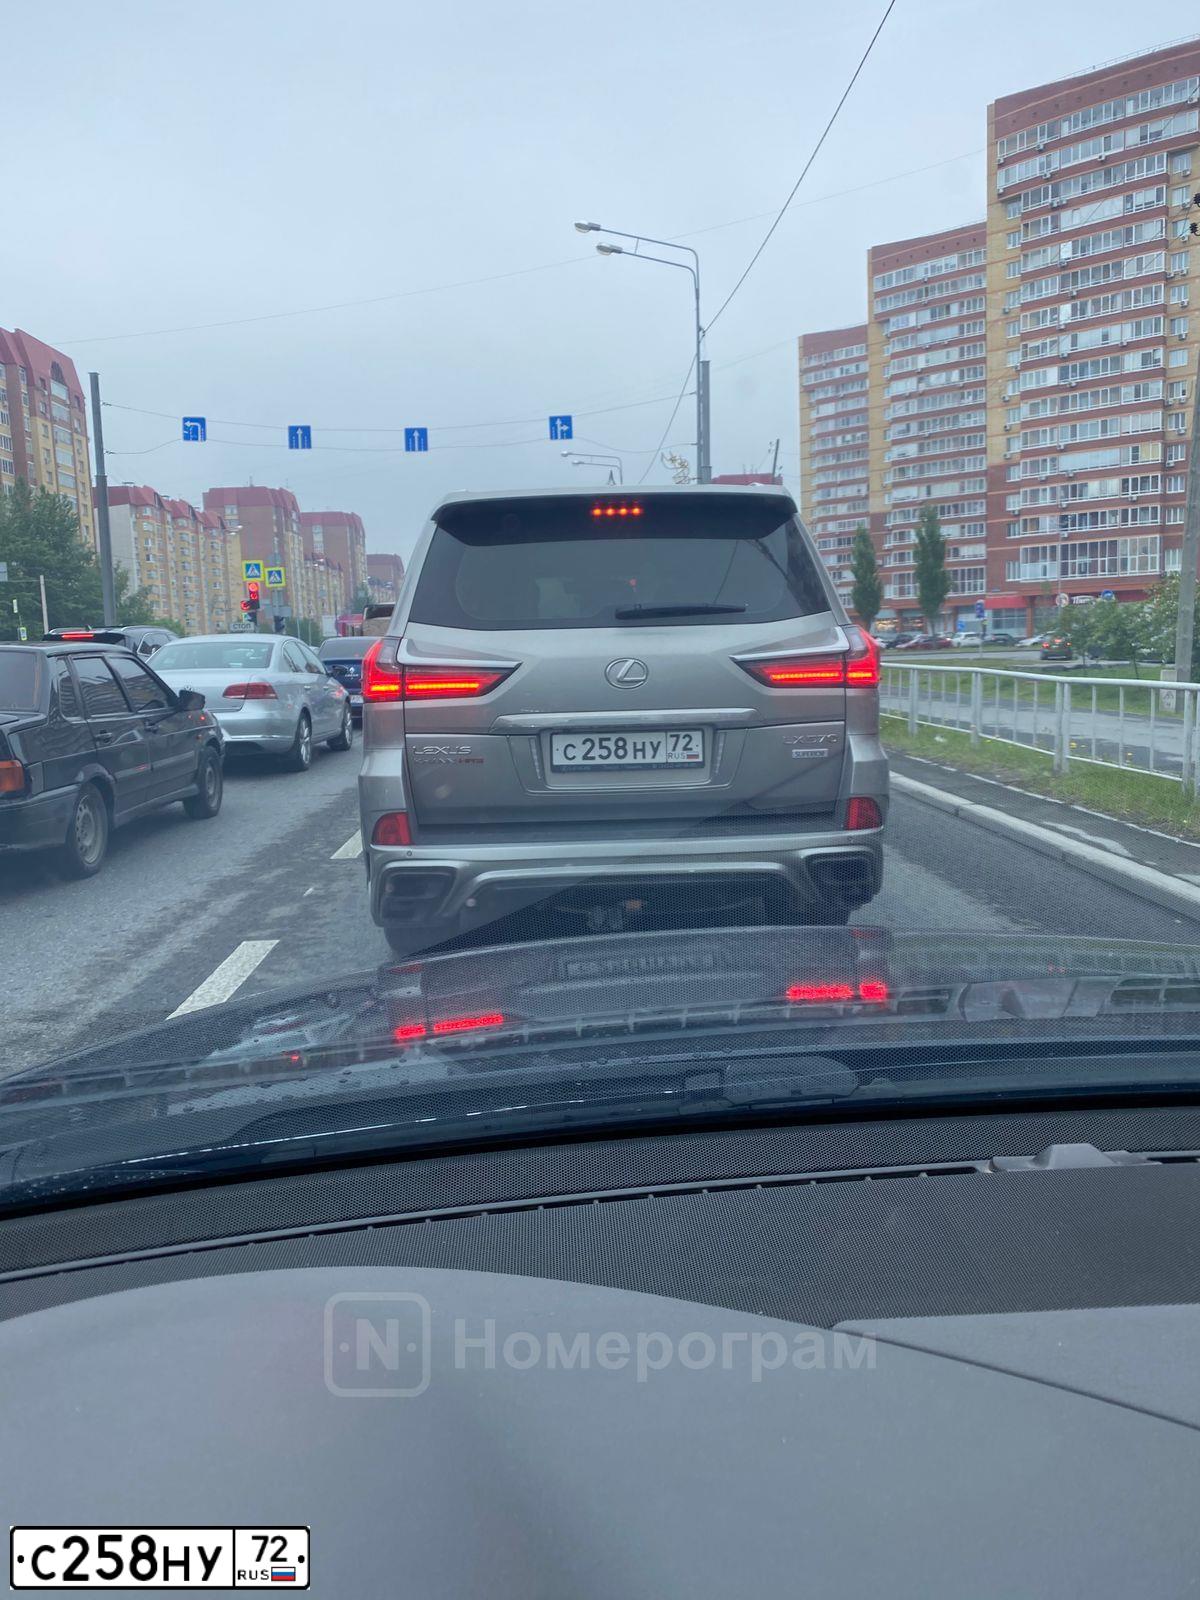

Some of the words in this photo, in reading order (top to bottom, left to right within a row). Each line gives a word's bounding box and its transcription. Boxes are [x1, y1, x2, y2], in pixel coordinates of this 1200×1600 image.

[669, 734, 694, 752] 72
[412, 745, 472, 755] LEXUS
[667, 752, 686, 760] RUS
